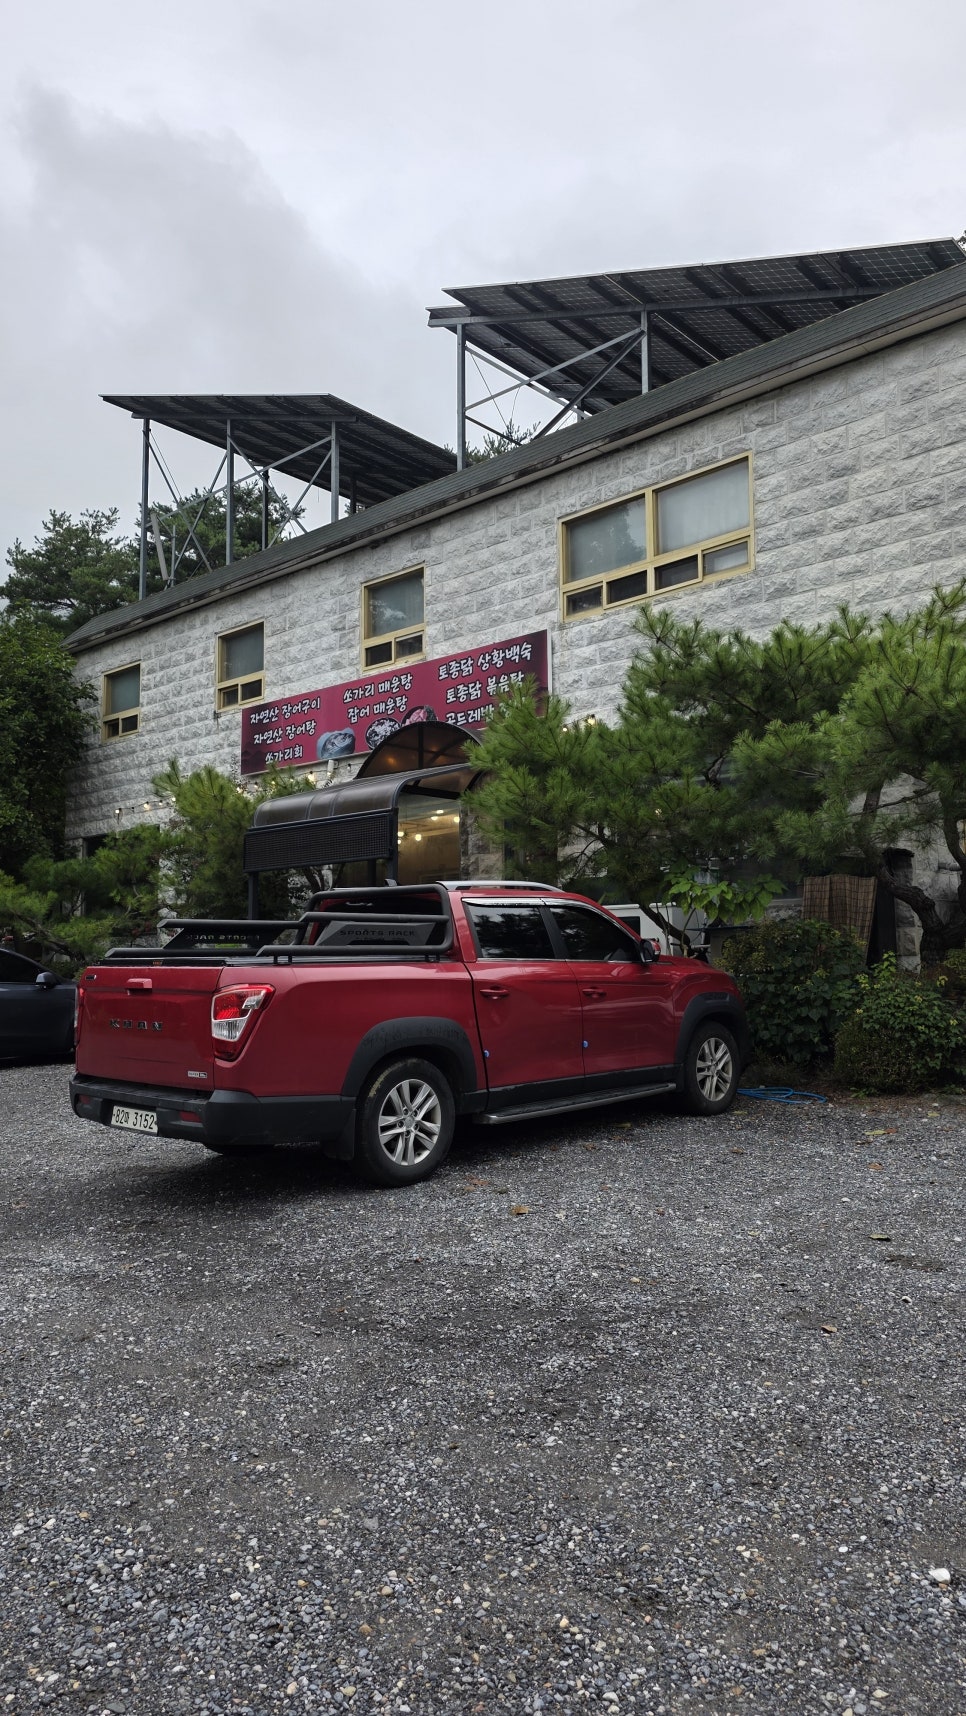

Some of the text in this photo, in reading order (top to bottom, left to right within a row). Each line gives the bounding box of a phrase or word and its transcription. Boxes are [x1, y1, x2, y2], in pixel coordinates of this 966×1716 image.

[438, 642, 532, 680] 토종닭 상황백숙
[343, 673, 413, 704] 쏘가리 매운탕
[446, 671, 525, 704] 토종닭 볶음탕
[250, 697, 321, 724] 자연산 장어구이
[347, 695, 408, 724] 잡어 매운탕
[253, 720, 317, 745] 자연산 장어탕
[264, 744, 304, 765] 쏘가리회
[131, 1112, 155, 1130] 3152
